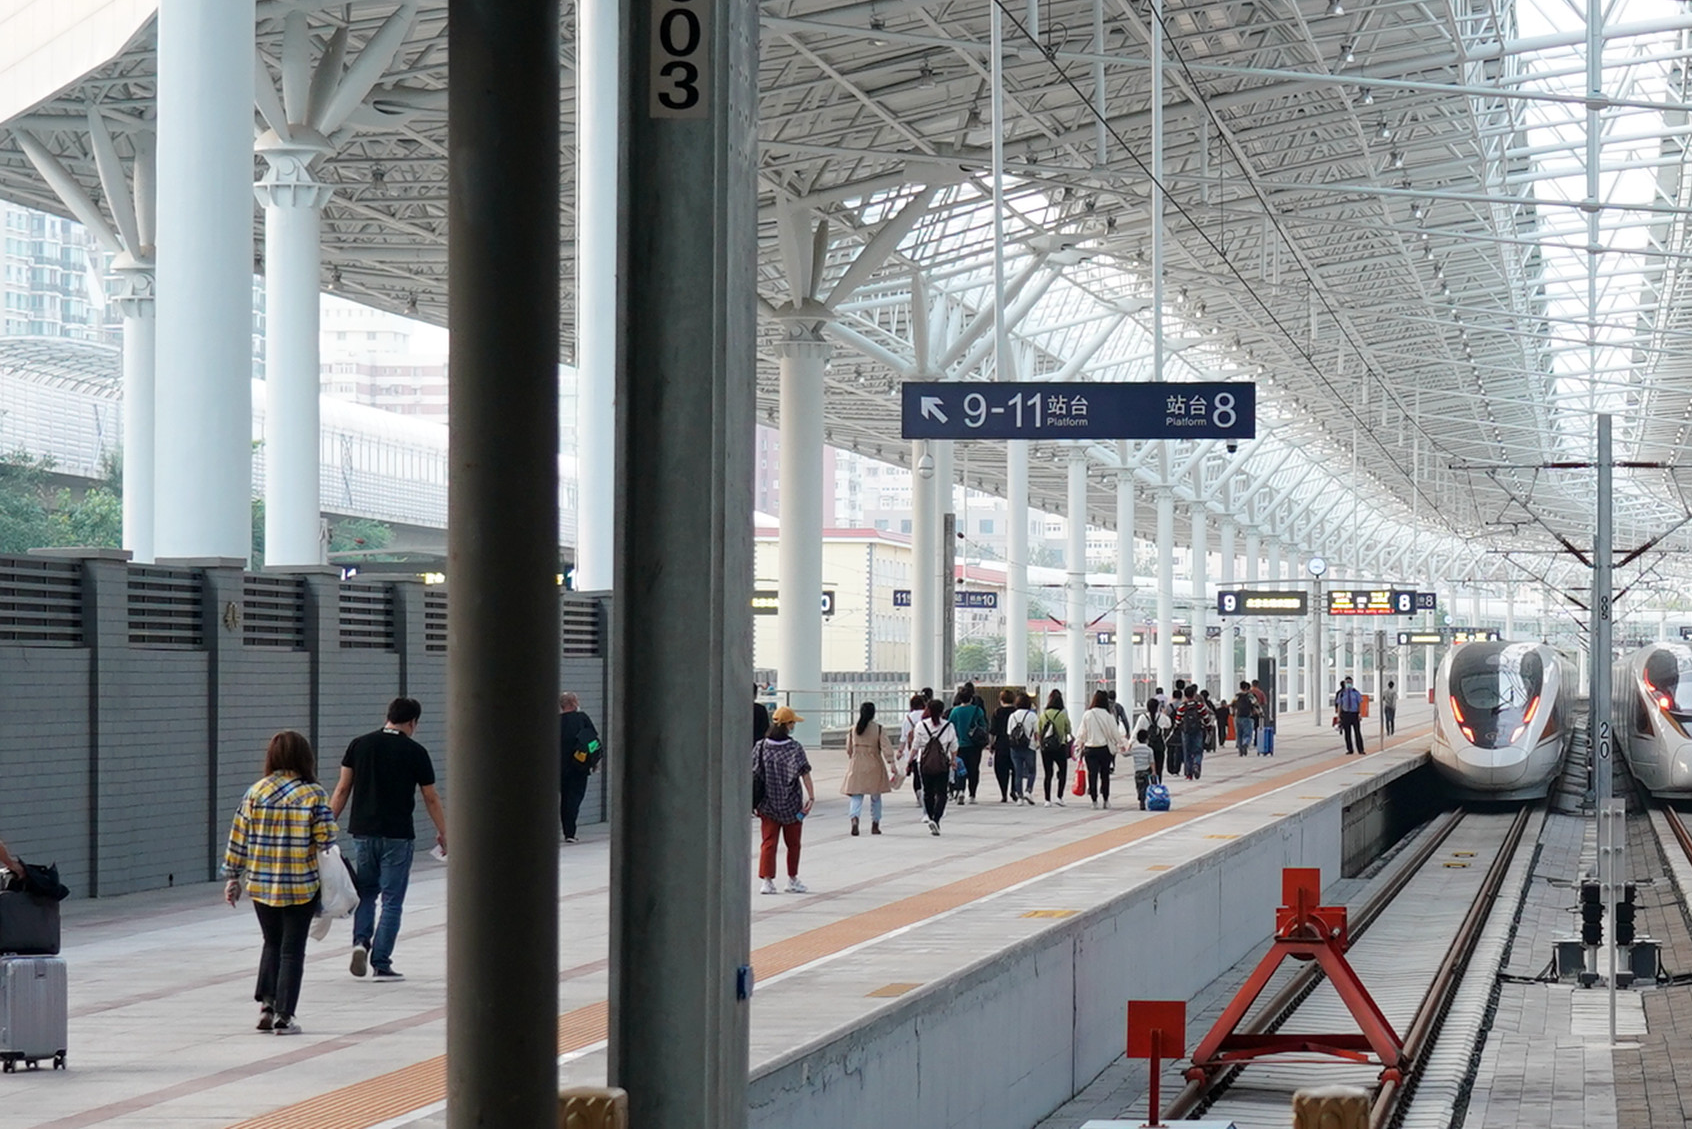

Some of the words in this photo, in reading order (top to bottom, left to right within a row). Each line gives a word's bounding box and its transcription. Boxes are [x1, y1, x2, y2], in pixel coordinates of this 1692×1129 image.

[963, 392, 1042, 428] 9-11
[1047, 395, 1089, 415] 站台
[1166, 394, 1207, 415] 站台
[1212, 392, 1237, 428] 8
[1047, 417, 1089, 427] Platform
[1166, 416, 1207, 426] Platform
[1223, 594, 1236, 612] 9
[1399, 594, 1411, 611] 8
[1425, 595, 1433, 607] 8
